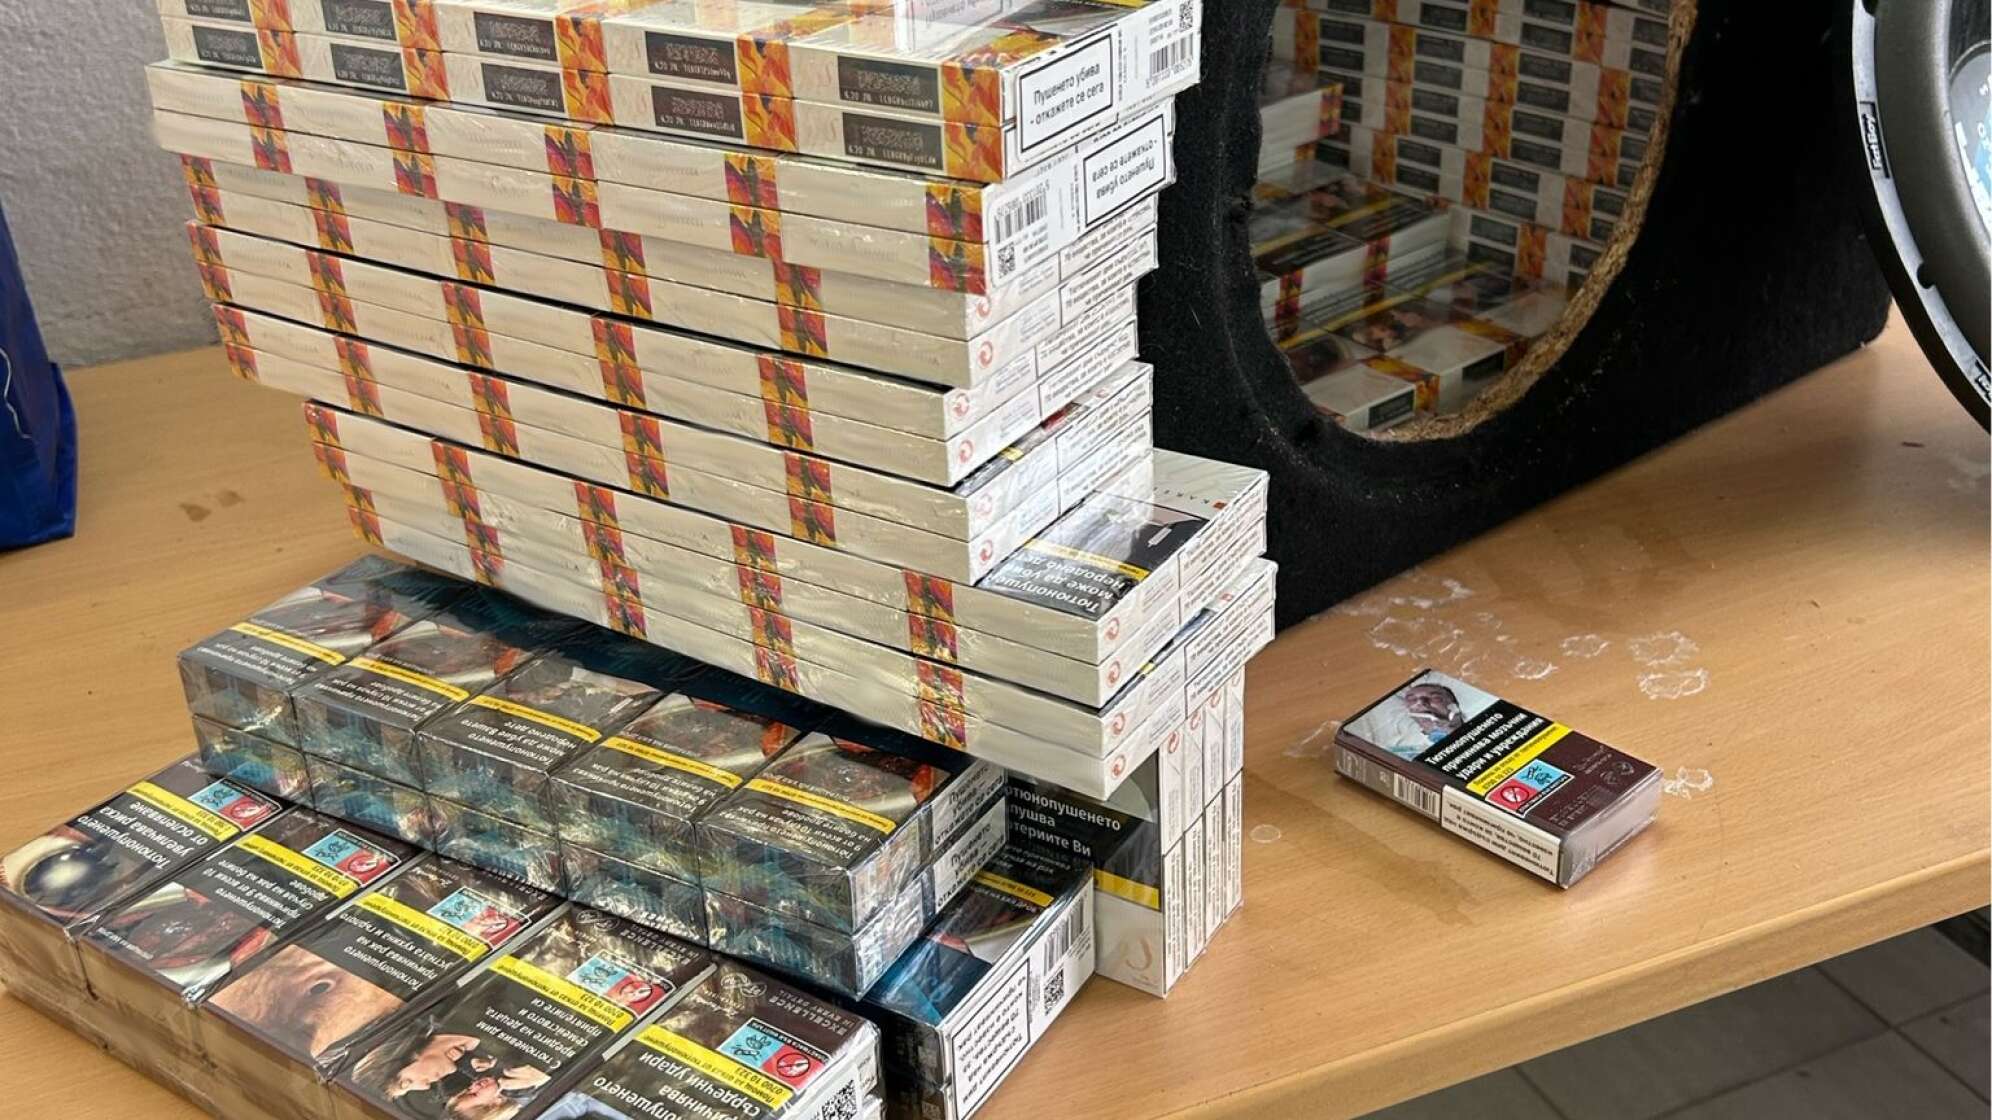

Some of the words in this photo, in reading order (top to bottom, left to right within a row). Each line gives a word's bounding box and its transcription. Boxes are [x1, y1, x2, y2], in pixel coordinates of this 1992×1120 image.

[1033, 74, 1074, 104] Пушенето
[1076, 63, 1100, 87] убива
[1036, 96, 1074, 125] откажете
[1076, 90, 1085, 104] се
[1087, 81, 1104, 101] сега
[1425, 713, 1504, 765] Тютюнопушенето
[1442, 737, 1491, 772] причинява
[1489, 713, 1527, 739] мозъчни
[1456, 755, 1485, 780] удари
[1490, 717, 1544, 757] увреждания
[100, 806, 137, 827] риска
[129, 802, 192, 836] ослепяване
[77, 815, 170, 869] Тютюнопушенето
[132, 822, 195, 857] увеличава
[191, 834, 208, 845] от
[1073, 840, 1091, 857] Ви
[344, 946, 422, 991] Тютюнопушенето
[388, 951, 438, 980] причинява
[532, 998, 544, 1007] си
[545, 1004, 601, 1038] приятелите
[768, 995, 848, 1035] EXCELLENCE
[527, 1013, 589, 1047] семейството
[640, 1052, 691, 1080] удари
[593, 1076, 685, 1120] опушенето
[685, 1072, 761, 1117] сърдечни
